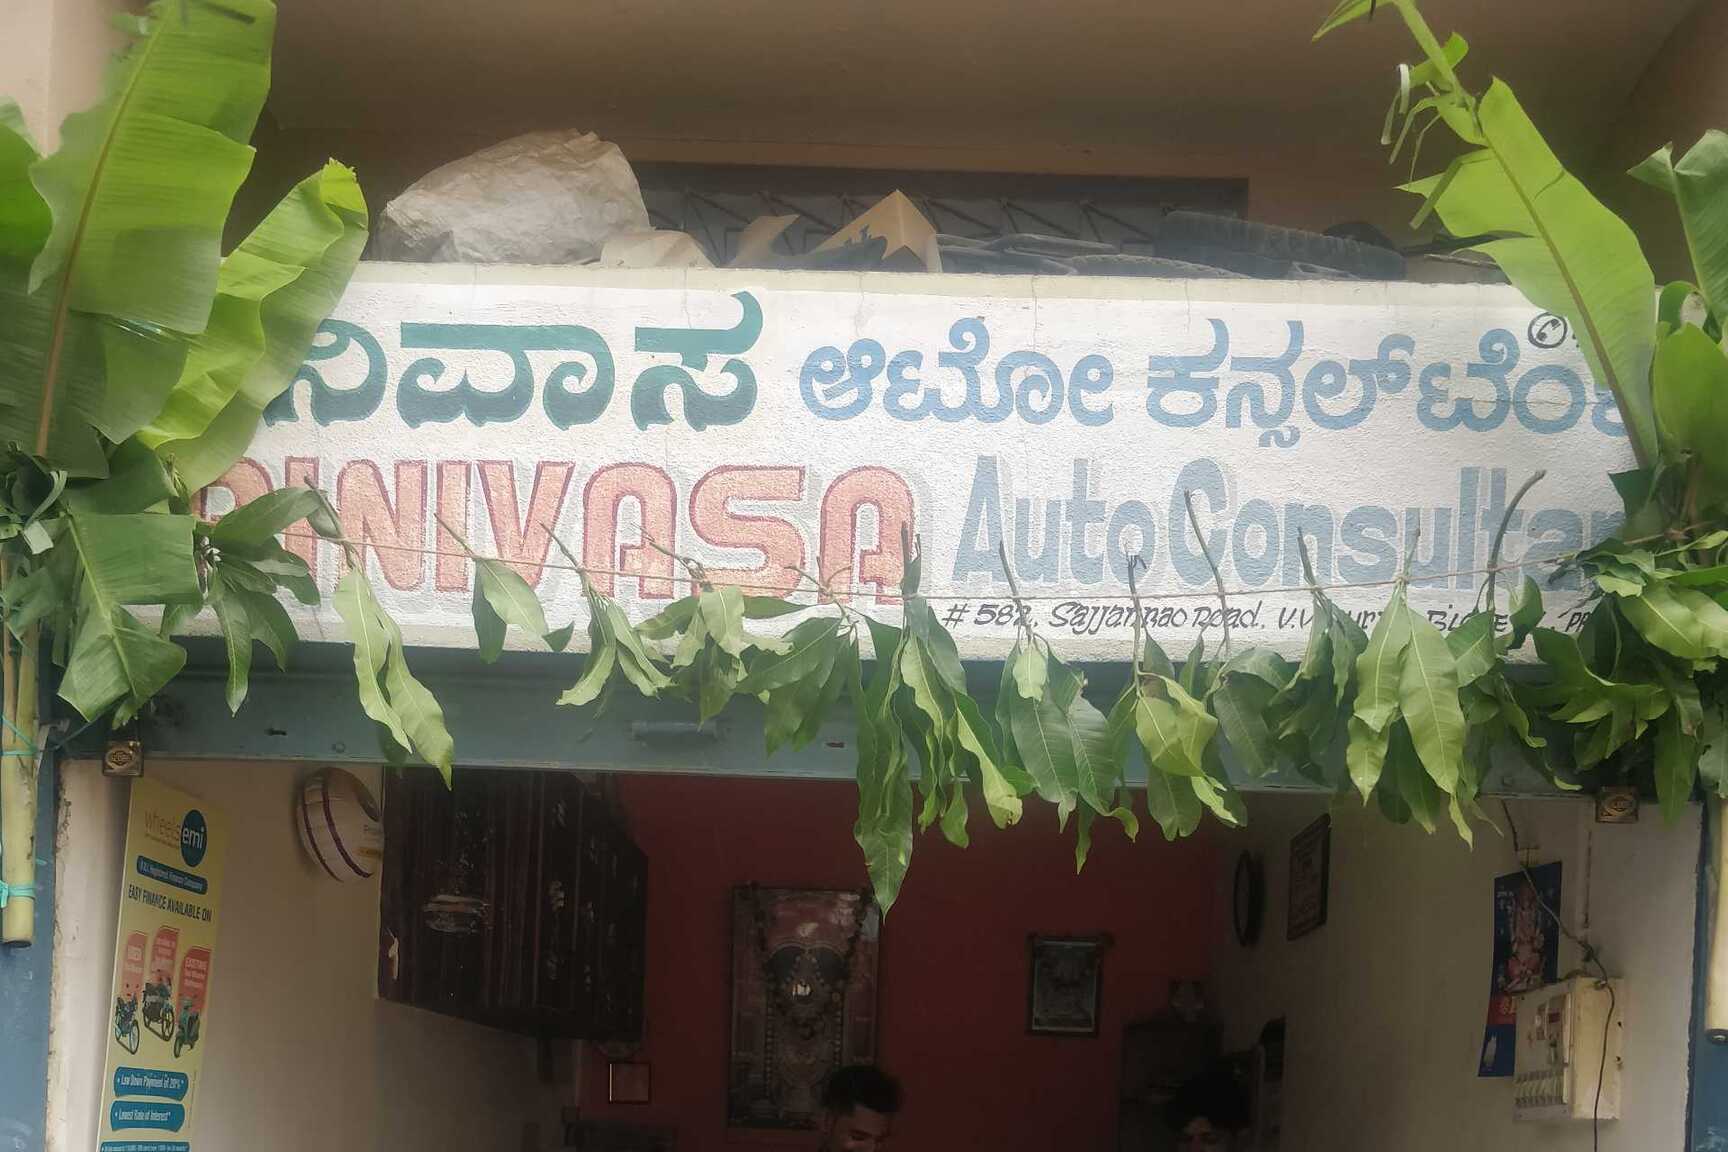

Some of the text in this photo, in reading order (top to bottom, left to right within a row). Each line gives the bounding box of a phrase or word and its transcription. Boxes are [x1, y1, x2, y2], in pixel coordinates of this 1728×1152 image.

[182, 826, 205, 849] emi
[143, 889, 167, 909] FINANCE
[167, 898, 201, 920] AVAILABLE
